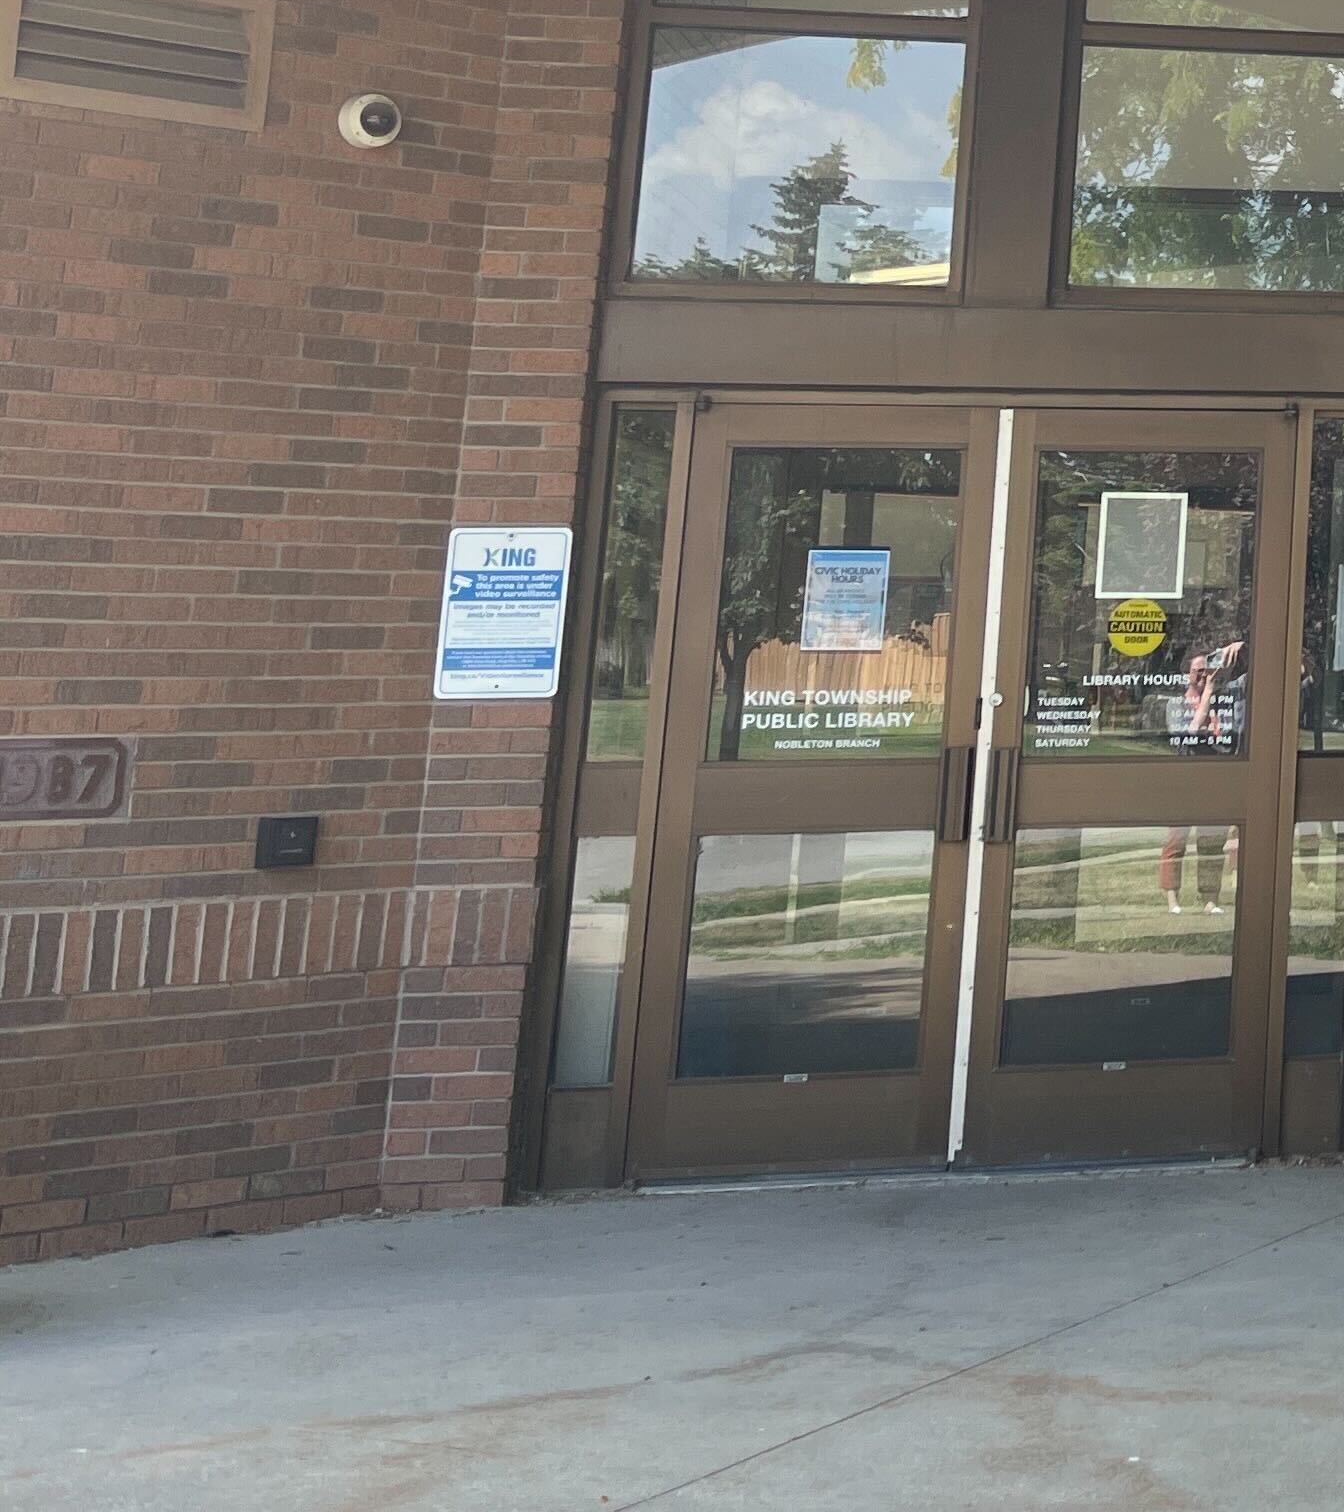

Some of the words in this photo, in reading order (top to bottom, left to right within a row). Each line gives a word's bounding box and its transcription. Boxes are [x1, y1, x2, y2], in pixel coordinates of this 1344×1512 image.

[482, 547, 536, 567] KING
[814, 567, 840, 576] CIVIC
[841, 567, 882, 576] HOLIDAY
[477, 574, 488, 582] To
[490, 574, 530, 583] promote
[531, 573, 560, 583] safety
[831, 575, 864, 584] HOURS
[475, 582, 493, 590] this
[526, 582, 554, 590] under
[475, 590, 501, 598] video
[503, 590, 557, 598] surveillance
[1114, 610, 1163, 619] AUTOMATIC
[1110, 621, 1164, 633] CAUTION
[1124, 636, 1149, 644] DOOR
[1082, 674, 1140, 686] LIBRARY
[1143, 673, 1190, 686] HOURS
[743, 689, 796, 706] KING
[802, 689, 912, 706] TOWNSHIP
[1037, 696, 1085, 707] TUESDAY
[1218, 695, 1234, 704] PM
[1036, 710, 1102, 720] WEDNESDAY
[741, 712, 820, 730] PUBLIC
[825, 712, 915, 729] LIBRARY
[1035, 724, 1092, 734] THURSDAY
[774, 739, 834, 749] NOBLETON
[835, 738, 881, 748] BRANCH
[1035, 738, 1090, 748] SATURDAY
[1170, 736, 1181, 746] 10
[1182, 736, 1198, 745] AM
[1216, 735, 1232, 745] PM
